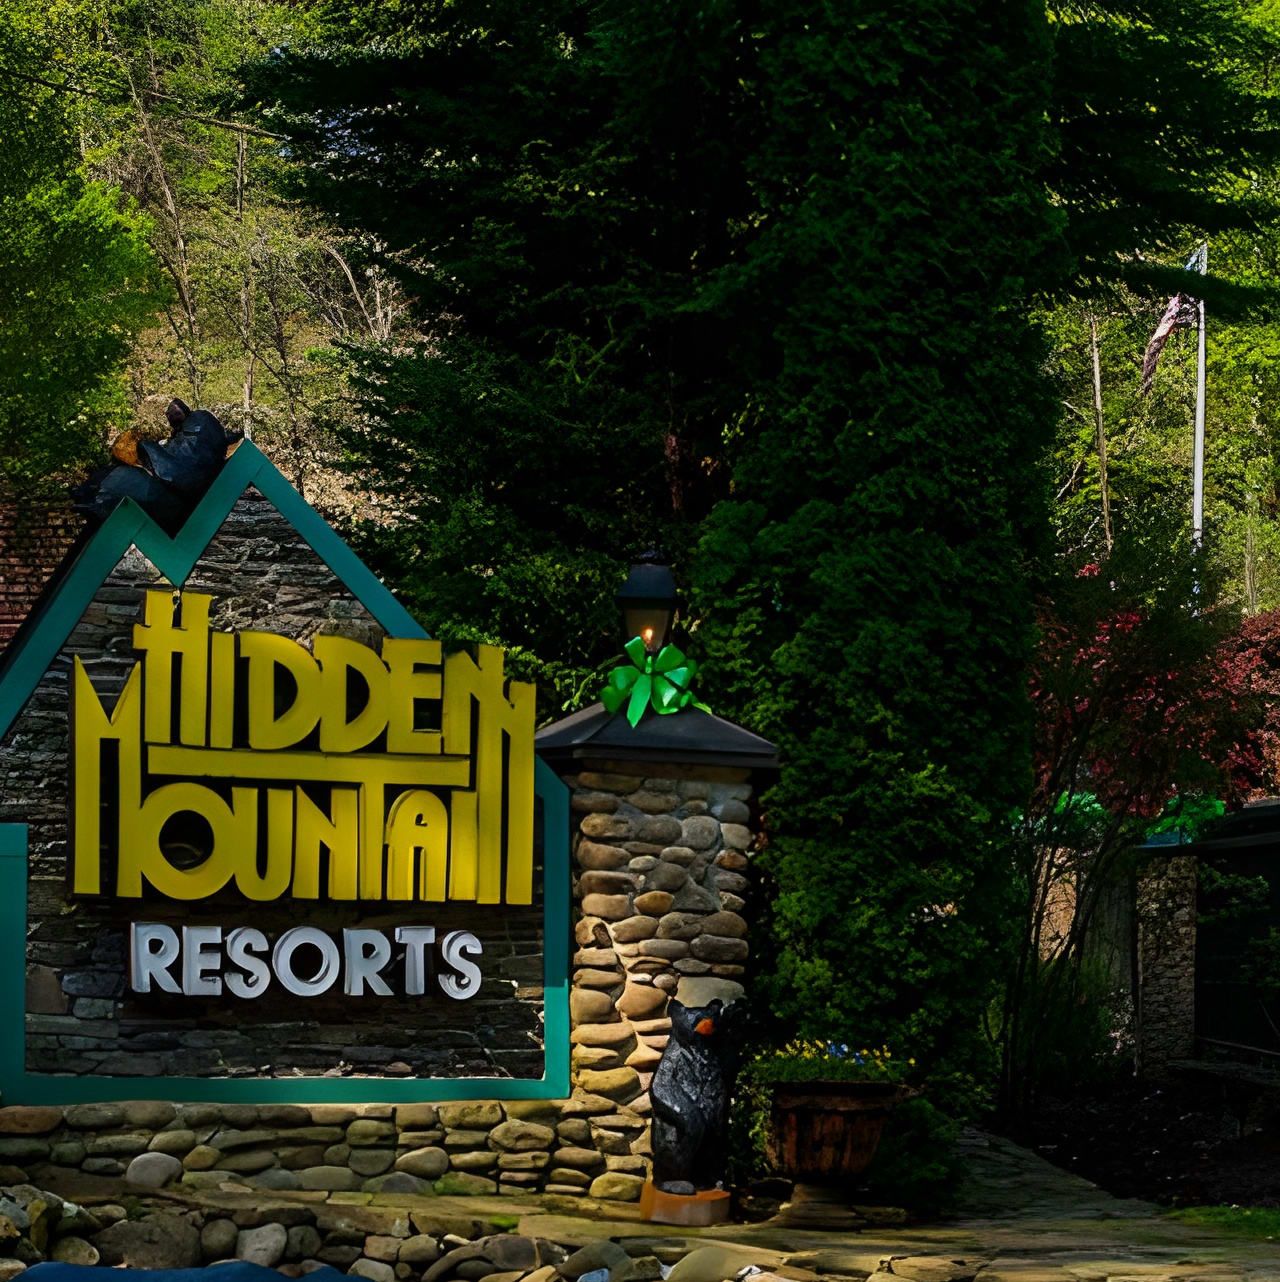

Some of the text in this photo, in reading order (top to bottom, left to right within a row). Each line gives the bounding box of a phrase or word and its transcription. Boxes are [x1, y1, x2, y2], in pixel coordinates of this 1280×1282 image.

[133, 589, 505, 755] HIDDEN
[73, 654, 537, 905] MOUNTAIN
[131, 921, 484, 1000] RESORTS
